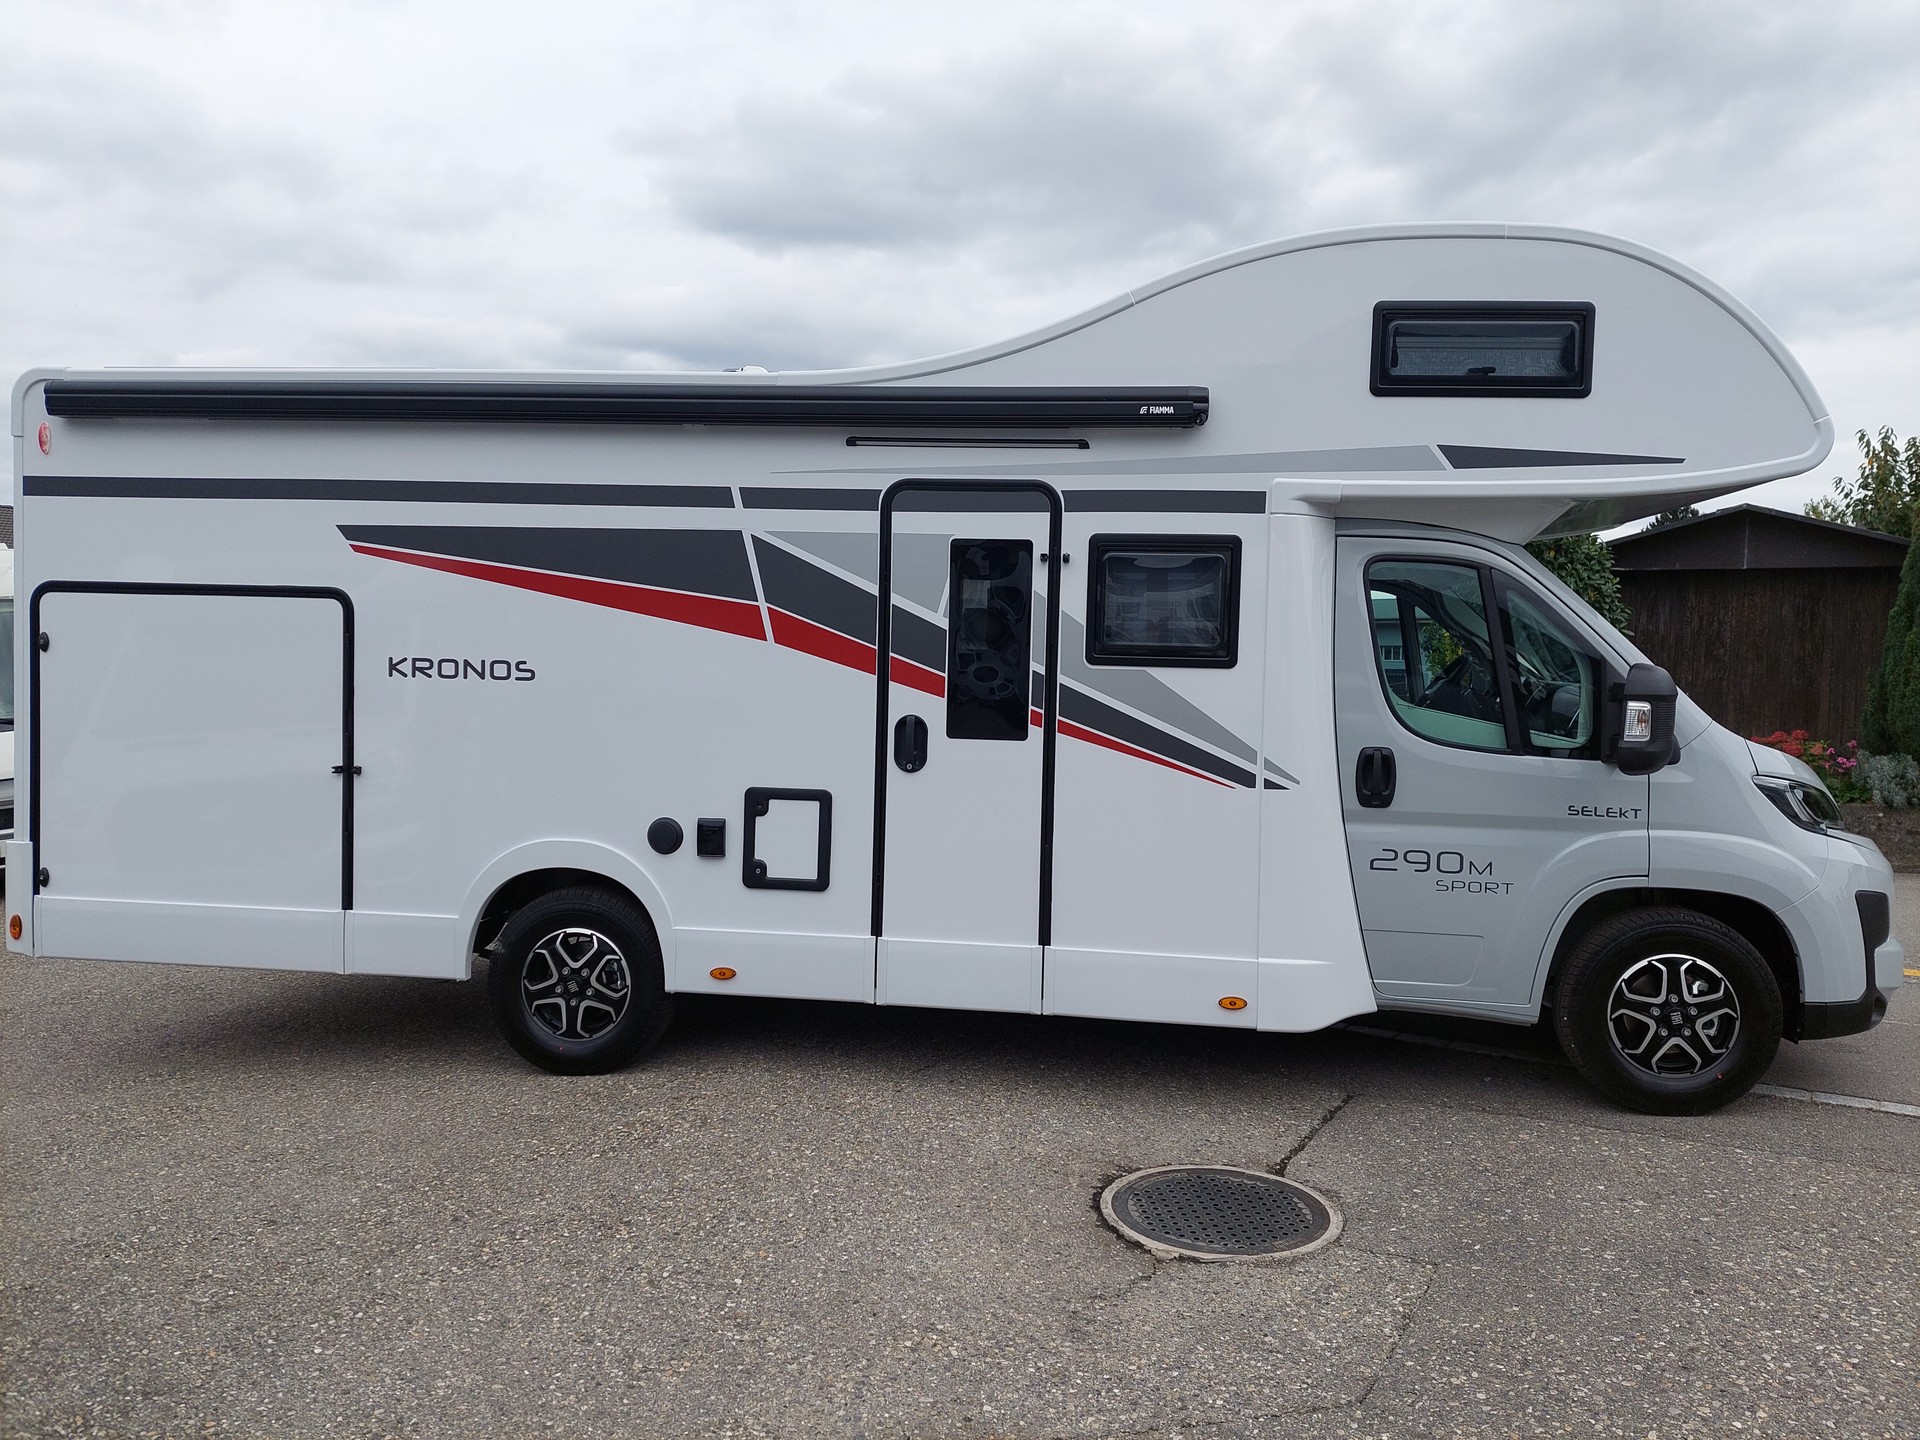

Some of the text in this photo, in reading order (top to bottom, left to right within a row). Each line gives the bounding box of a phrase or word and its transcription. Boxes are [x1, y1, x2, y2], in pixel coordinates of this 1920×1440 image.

[1149, 406, 1174, 414] FIAMMA
[388, 656, 536, 682] KRONOS
[1435, 879, 1515, 895] SPORT
[566, 980, 579, 993] FIAT
[1670, 1011, 1683, 1025] FIAT
